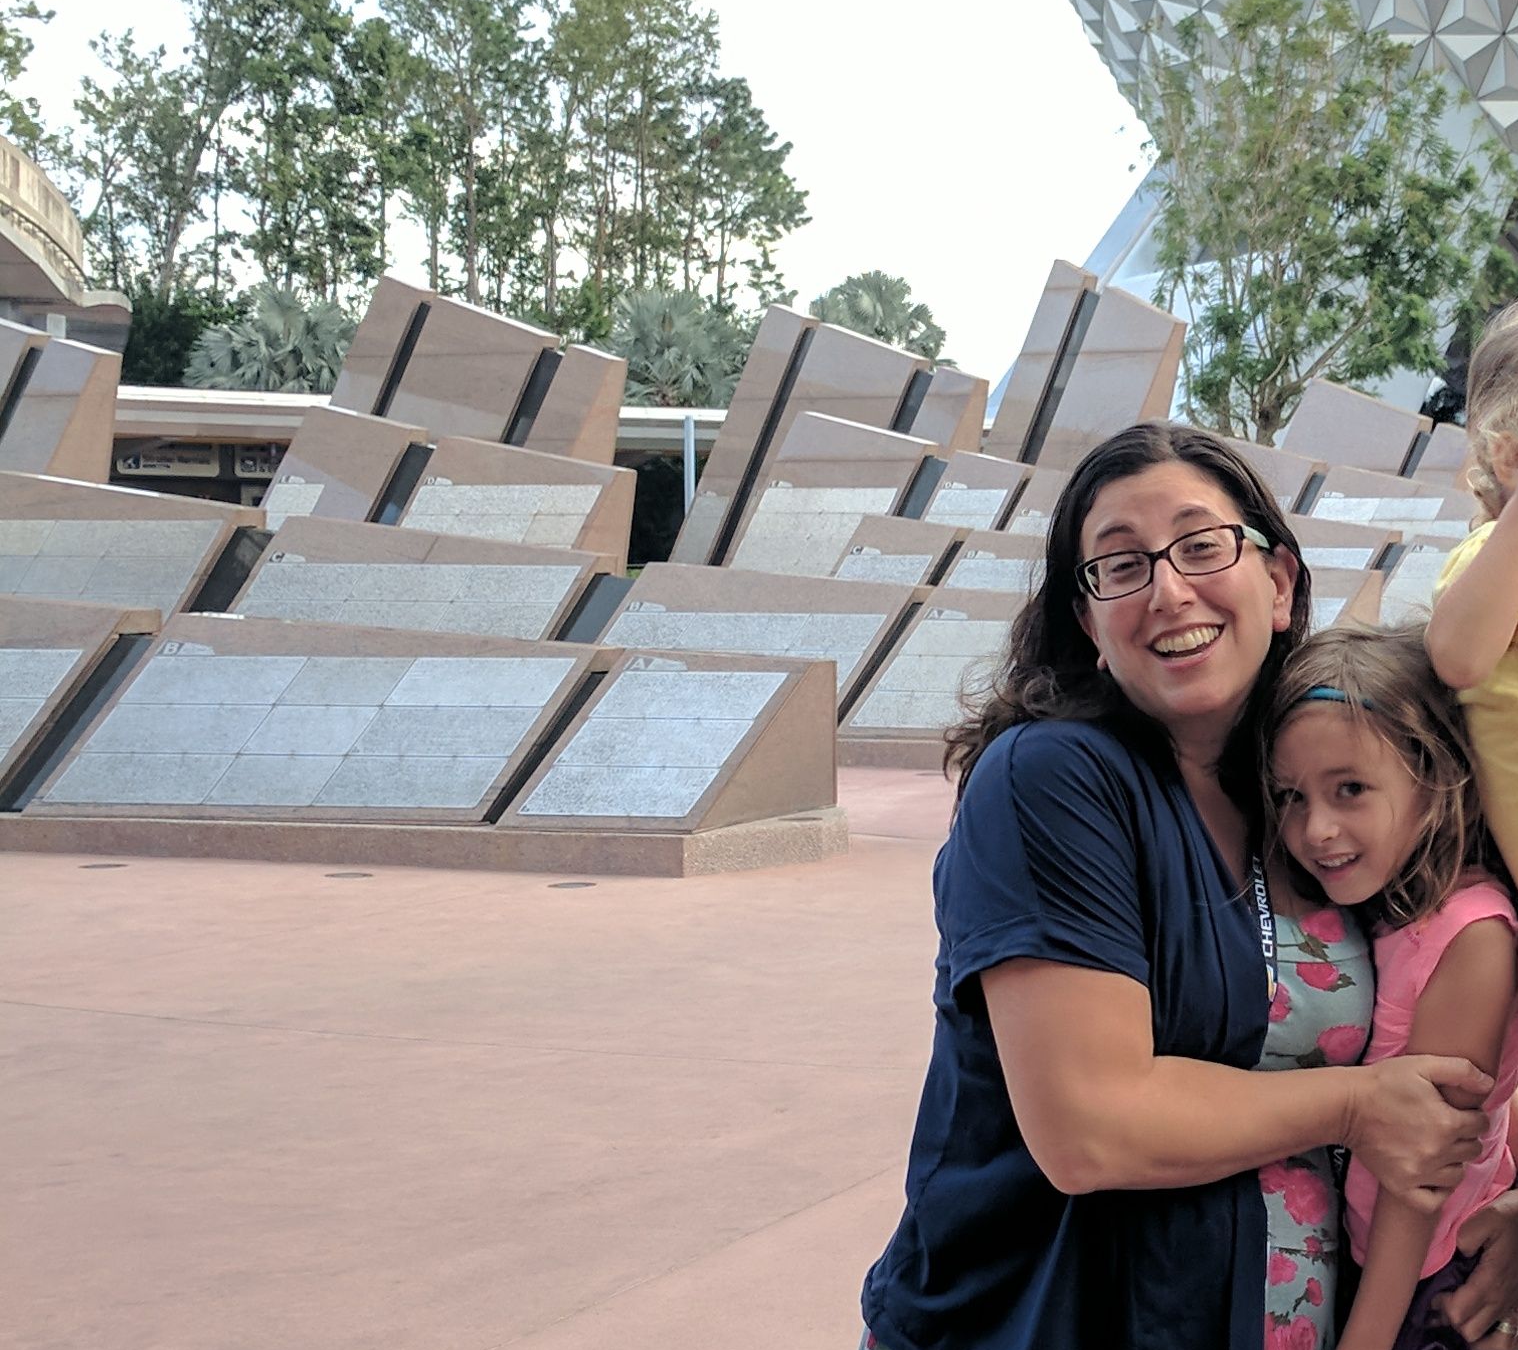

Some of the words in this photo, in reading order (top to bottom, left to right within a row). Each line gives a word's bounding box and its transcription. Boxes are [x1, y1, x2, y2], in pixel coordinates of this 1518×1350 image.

[271, 551, 284, 562] C
[162, 642, 180, 656] B
[631, 657, 648, 671] A
